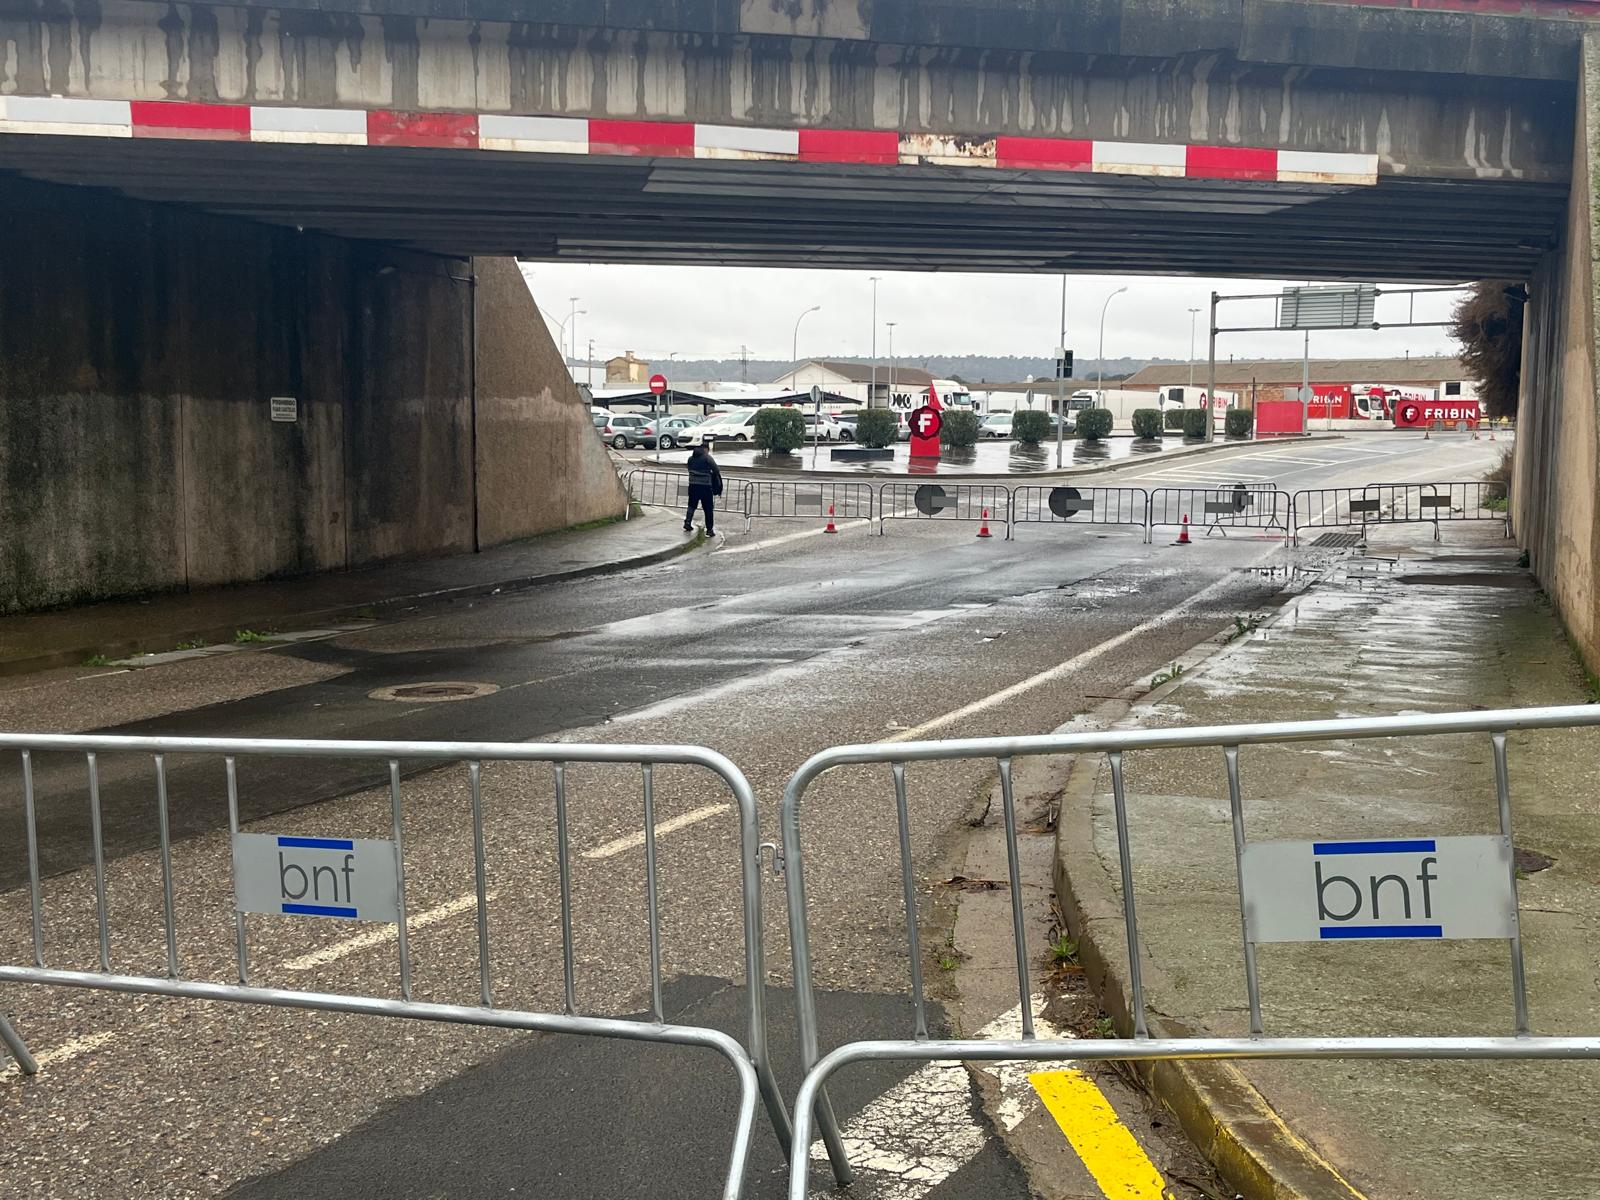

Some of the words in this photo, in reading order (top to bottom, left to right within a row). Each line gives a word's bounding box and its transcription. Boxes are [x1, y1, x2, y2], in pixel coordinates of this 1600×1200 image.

[1312, 395, 1343, 404] RIBN
[917, 413, 933, 433] F
[1424, 408, 1476, 419] FRIBIN
[278, 851, 355, 903] bnf
[1314, 857, 1438, 921] bnf
